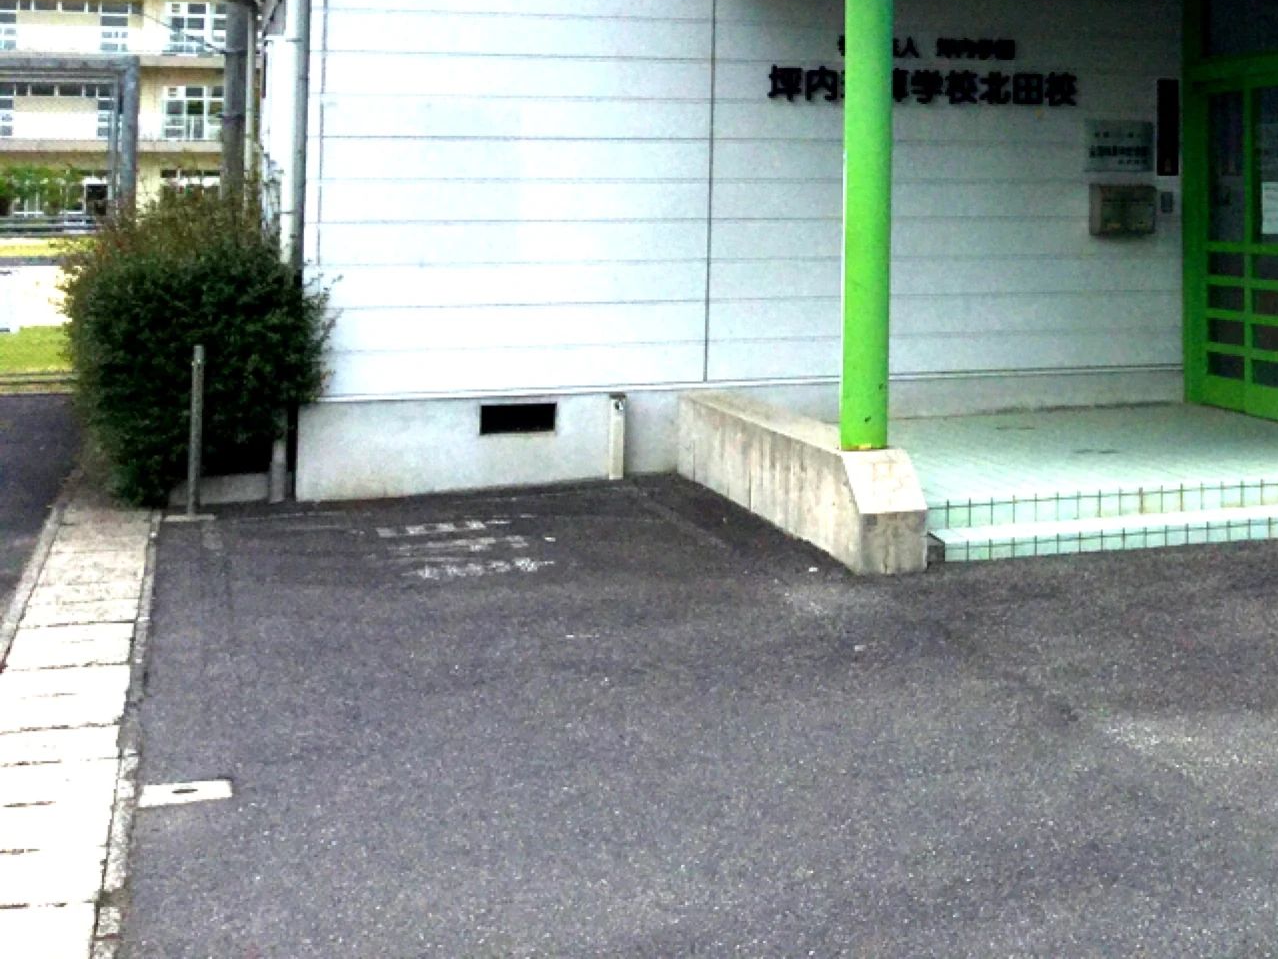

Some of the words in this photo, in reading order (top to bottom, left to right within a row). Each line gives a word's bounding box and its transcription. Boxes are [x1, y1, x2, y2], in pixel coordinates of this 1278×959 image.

[768, 65, 1078, 107] 坪内学校北田校
